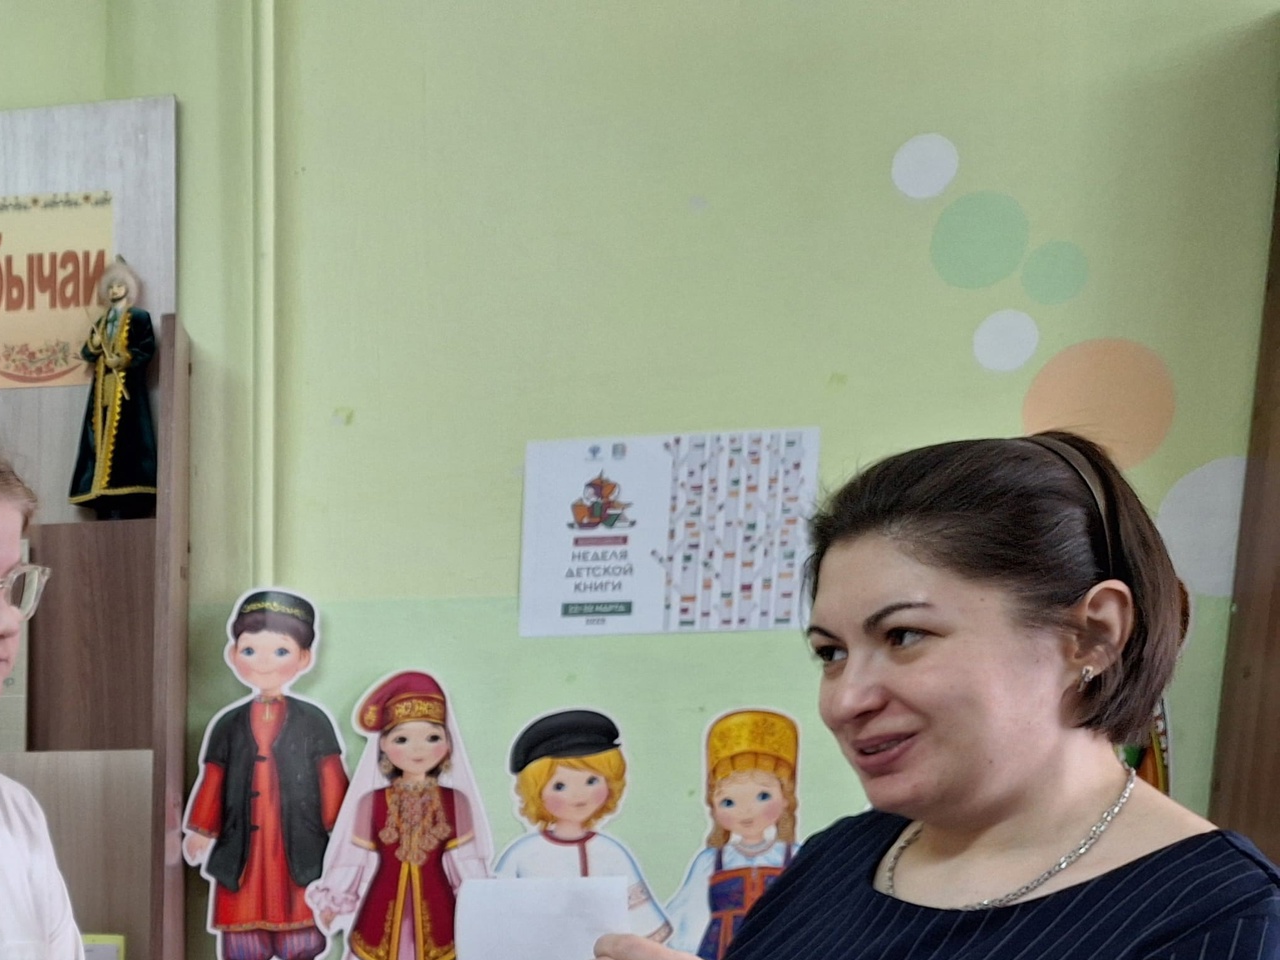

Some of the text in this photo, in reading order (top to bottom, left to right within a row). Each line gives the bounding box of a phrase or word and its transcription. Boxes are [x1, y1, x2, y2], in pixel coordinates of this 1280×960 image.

[571, 550, 628, 562] НЕДЕЛЯ
[565, 563, 634, 578] ДЕТСКОЙ
[573, 581, 623, 592] КНИГИ
